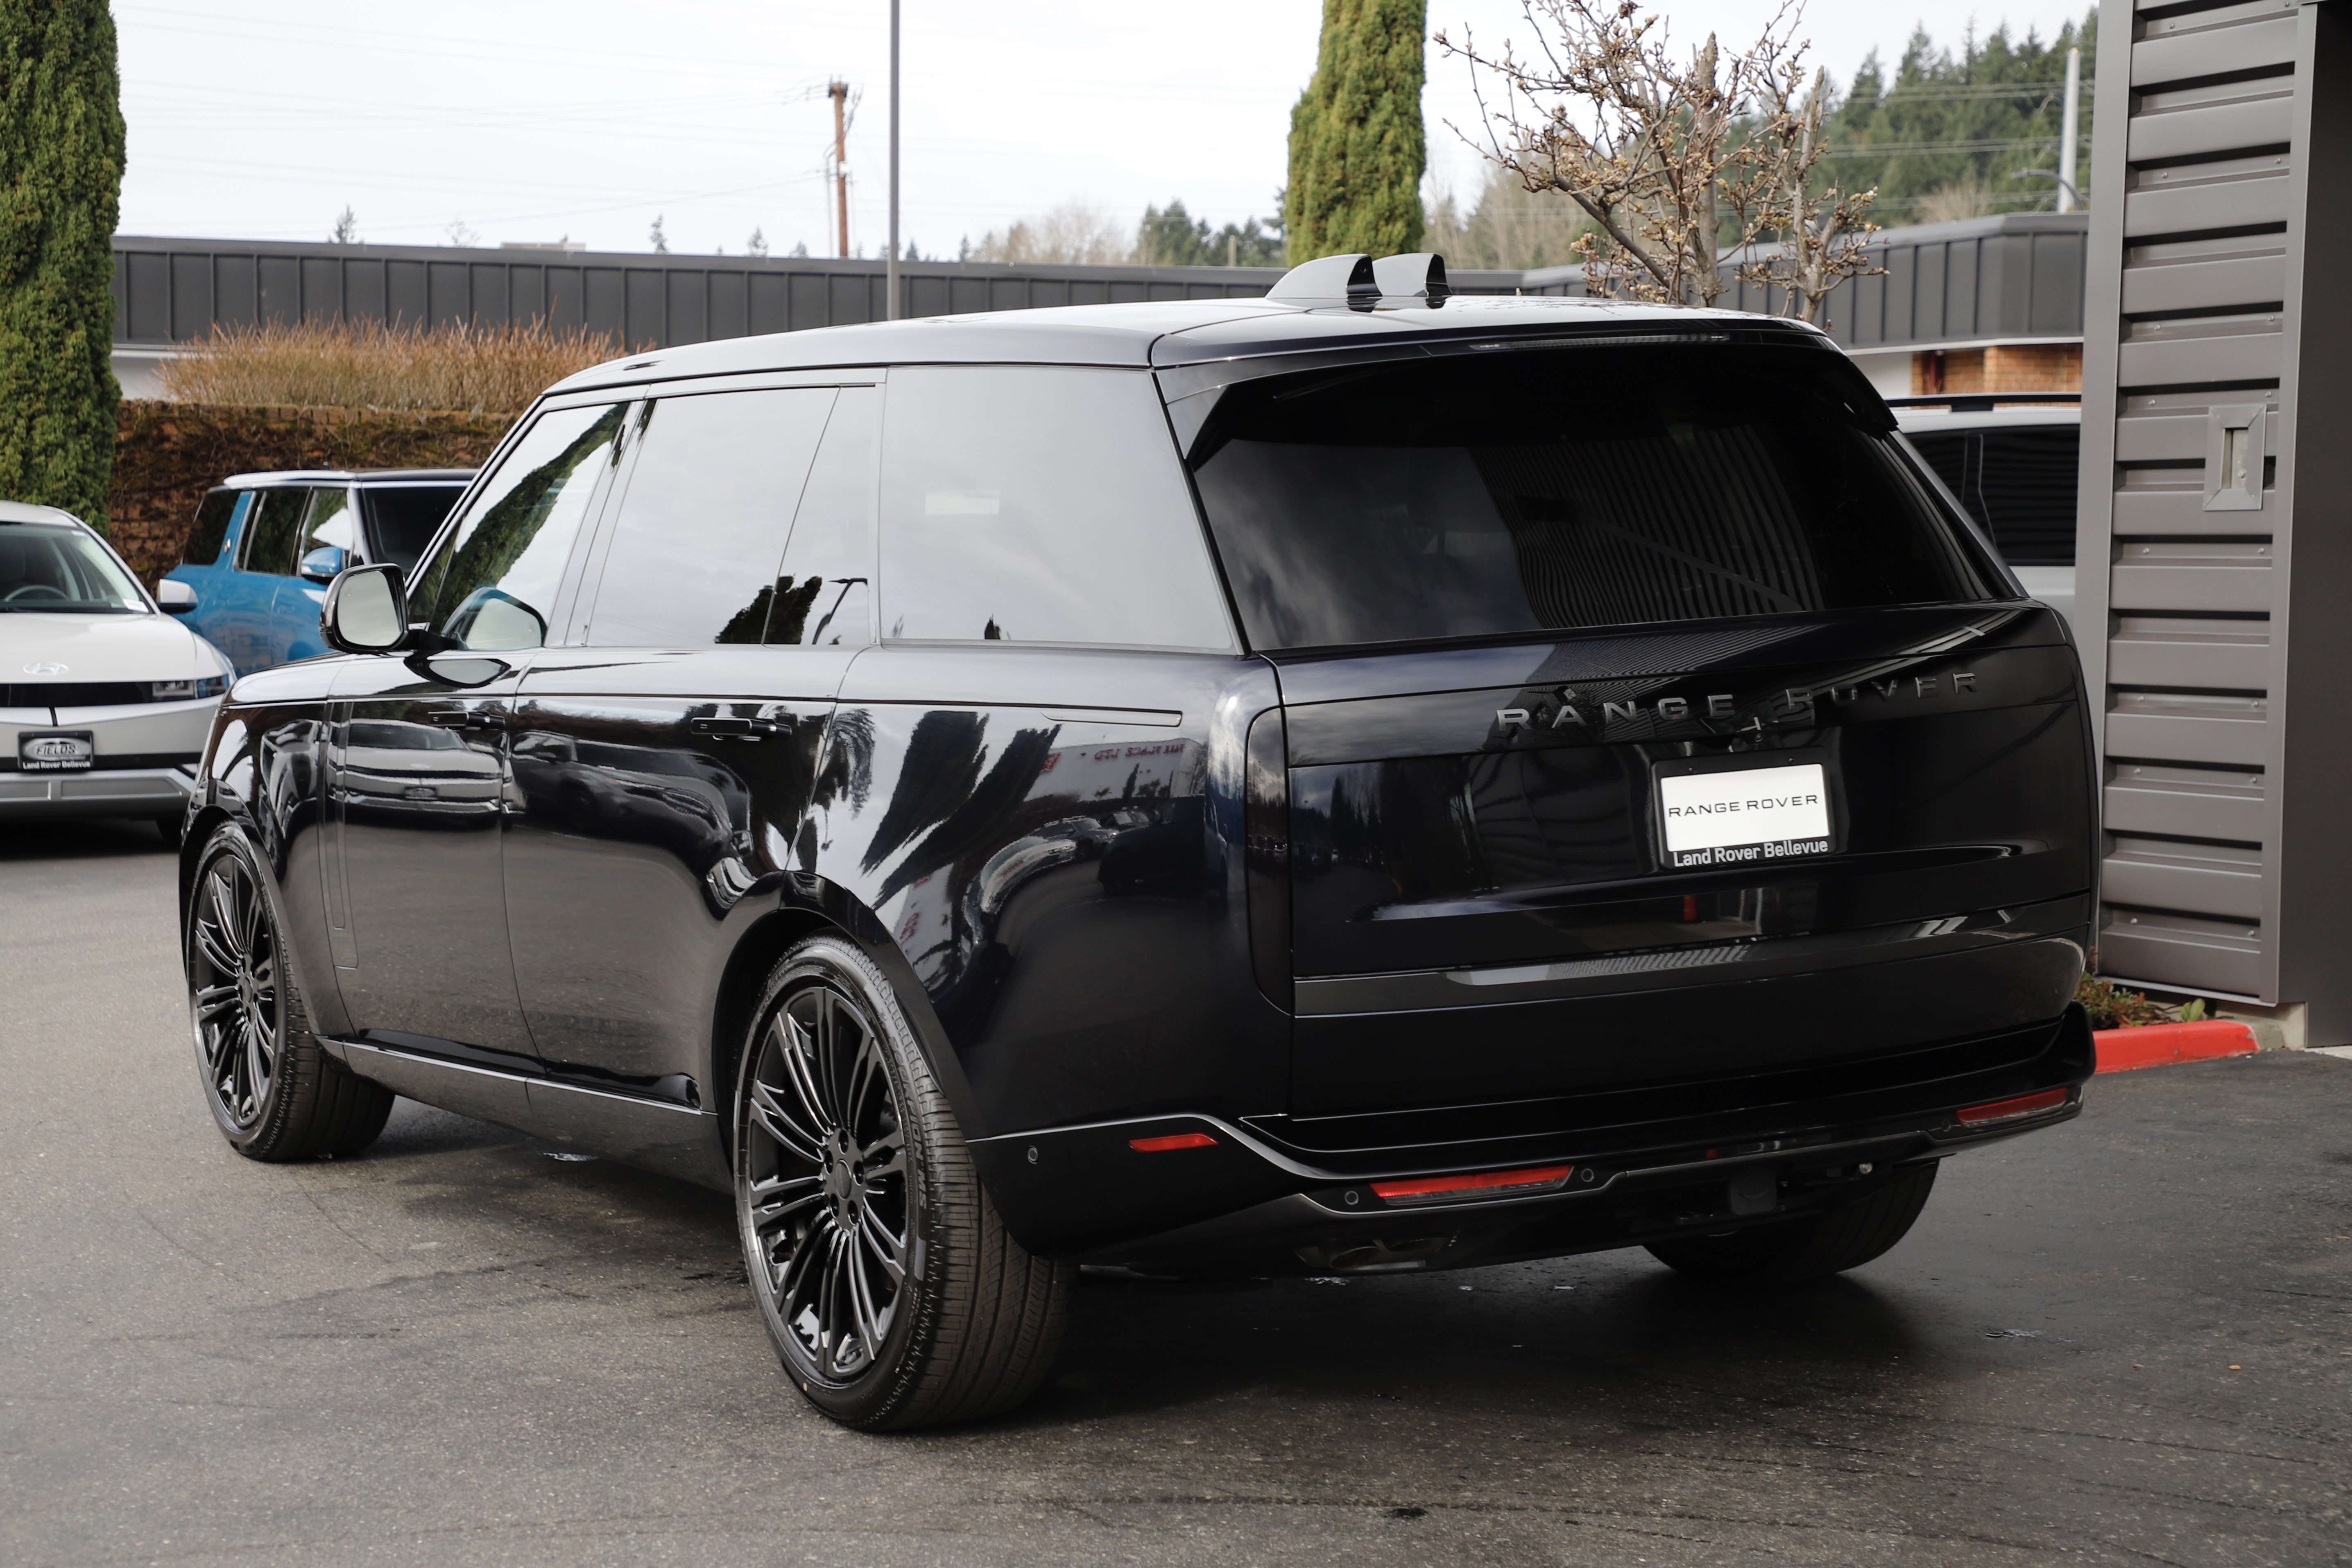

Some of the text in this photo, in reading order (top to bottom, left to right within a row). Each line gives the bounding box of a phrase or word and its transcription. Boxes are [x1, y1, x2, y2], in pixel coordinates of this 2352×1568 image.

[1496, 672, 1977, 731] RANGE ROVER
[23, 760, 91, 769] Land Rover Bellevue
[1668, 794, 1818, 817] RANGE ROVER
[1673, 839, 1829, 867] Land Rover Bellevue
